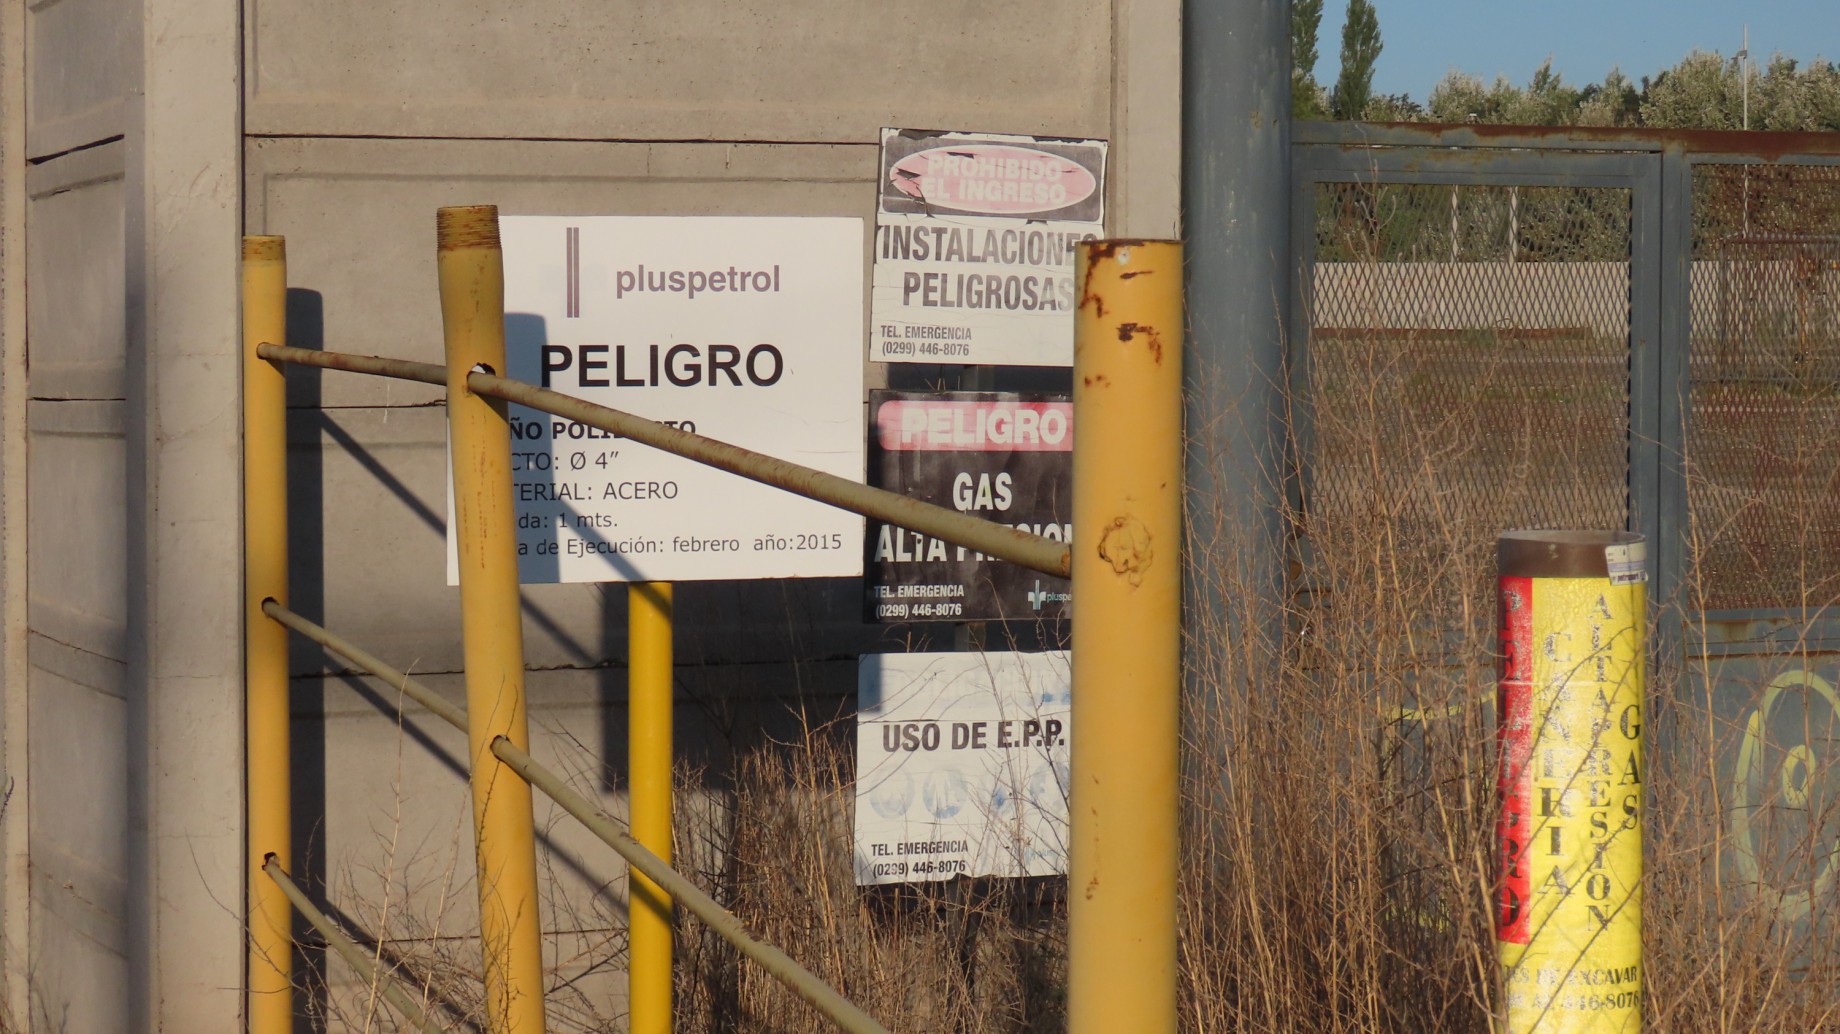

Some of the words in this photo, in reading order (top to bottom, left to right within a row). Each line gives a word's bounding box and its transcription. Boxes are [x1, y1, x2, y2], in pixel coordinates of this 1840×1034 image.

[928, 155, 1062, 181] PROHIBIDO
[921, 178, 951, 198] EL
[959, 180, 1066, 204] INGRESO
[616, 264, 780, 299] pluspetrol
[903, 272, 1074, 311] PELIGROSAS
[881, 325, 901, 338] TEL.
[904, 326, 972, 340] EMERGENCIA
[882, 342, 916, 357] (0299)
[919, 343, 969, 356] 446-8076
[541, 344, 784, 387] PELIGRO
[901, 409, 1067, 444] PELIGRO
[603, 481, 678, 500] ACERO
[952, 472, 1013, 511] GAS
[559, 512, 568, 528] 1
[577, 513, 618, 528] mts.
[536, 538, 559, 555] de
[567, 536, 663, 558] Ejecución:
[672, 536, 740, 552] febrero
[874, 524, 947, 562] ALTA
[874, 586, 895, 598] TEL.
[897, 584, 964, 598] EMERGENCIA
[875, 604, 909, 619] (0299)
[911, 603, 962, 617] 446-8076
[883, 722, 940, 752] USO
[952, 722, 987, 749] DE
[997, 719, 1065, 749] E.P.P.
[1617, 703, 1641, 830] GAS
[872, 843, 894, 857] TEL.
[897, 840, 968, 855] EMERGENCIA
[912, 860, 965, 875] 446-8076
